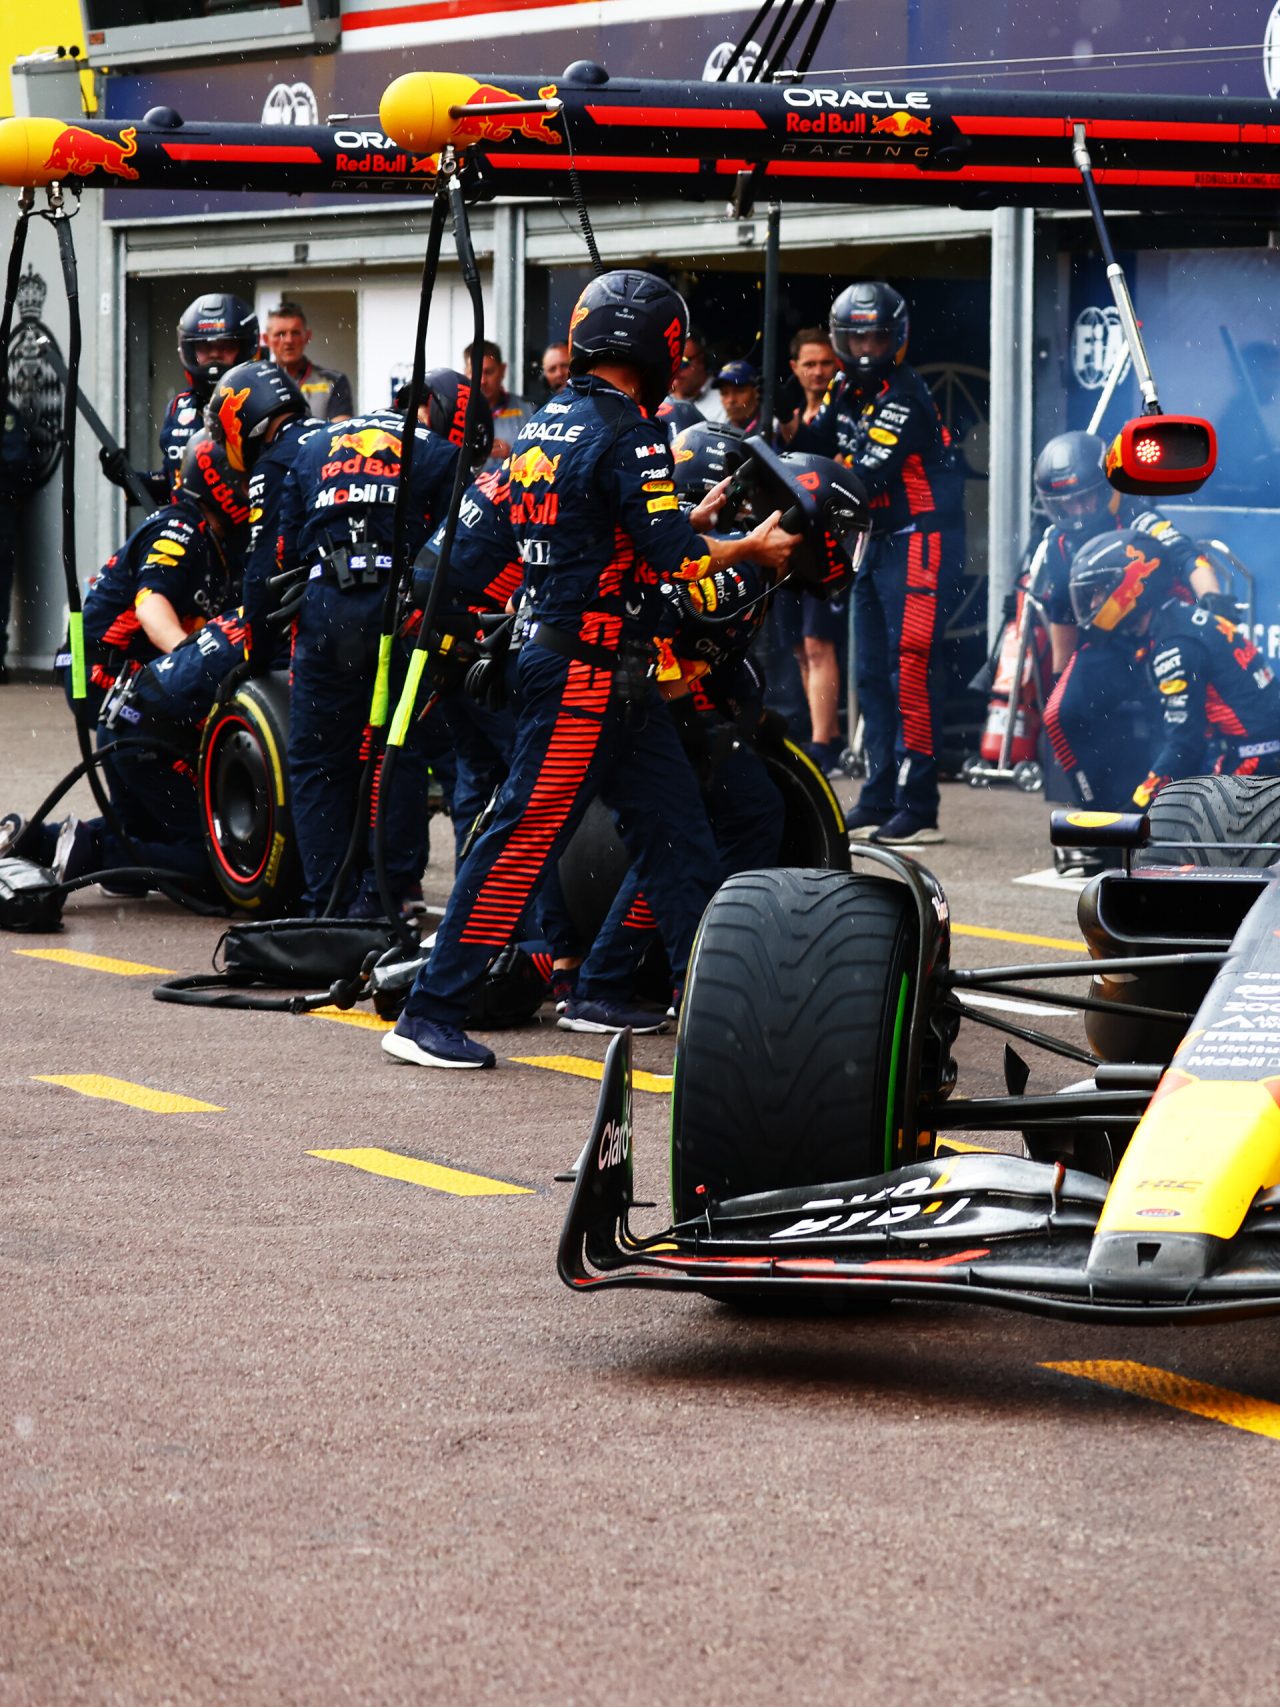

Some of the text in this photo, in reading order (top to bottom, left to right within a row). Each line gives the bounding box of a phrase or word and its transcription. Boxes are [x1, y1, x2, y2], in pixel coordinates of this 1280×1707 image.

[783, 88, 932, 110] ORACLE
[786, 112, 866, 134] Red Bull
[782, 144, 929, 157] RACING
[336, 153, 406, 172] Red Bull
[517, 422, 586, 443] ORACLE
[314, 483, 377, 509] Mobil
[1187, 1056, 1266, 1067] Mobil
[598, 1118, 629, 1171] Claro
